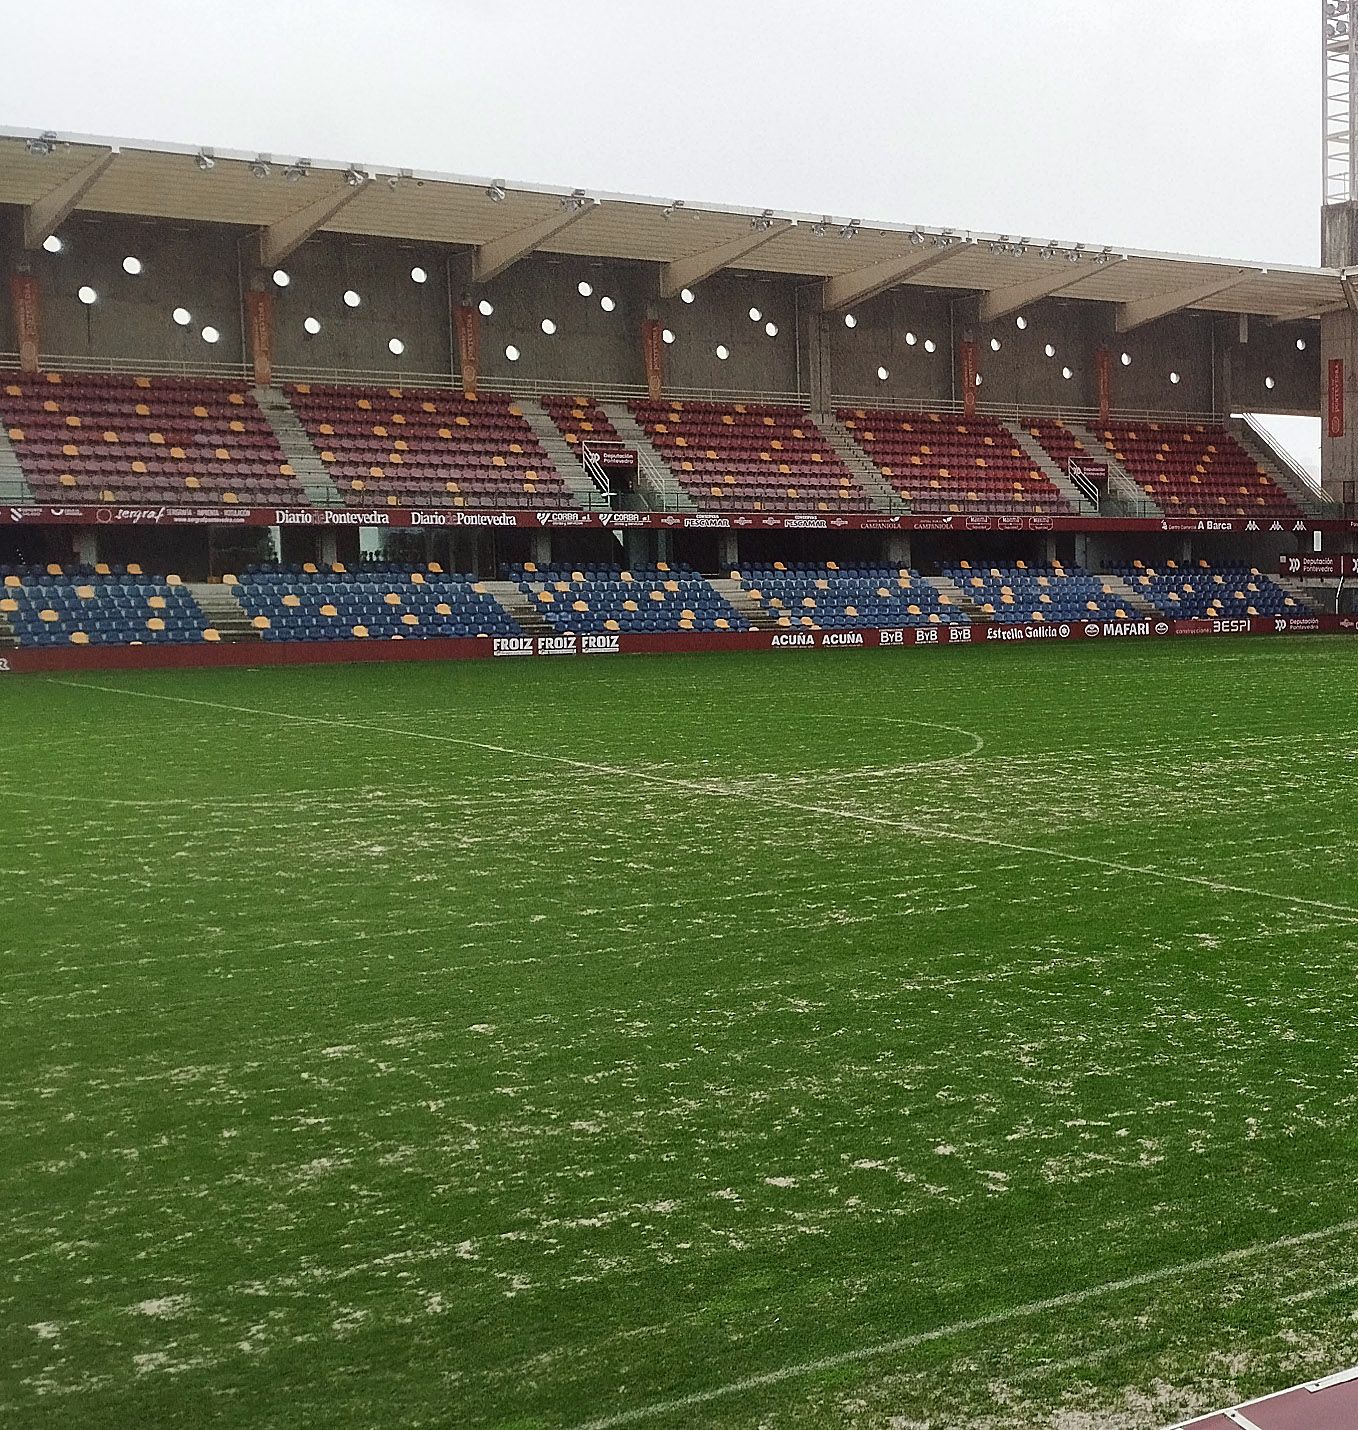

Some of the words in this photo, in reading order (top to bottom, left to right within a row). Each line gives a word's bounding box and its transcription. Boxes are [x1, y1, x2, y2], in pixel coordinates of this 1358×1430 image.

[275, 510, 312, 524] Diario
[324, 510, 389, 524] Pontevedra
[411, 512, 445, 525] Diario
[457, 512, 517, 526] Pontevedra
[684, 519, 730, 527] PESCAMAR
[785, 520, 827, 528] PESCAMAR
[1197, 521, 1205, 530] A
[1207, 521, 1232, 530] Barca
[987, 627, 1024, 640] Estrella
[1025, 625, 1057, 639] Galicia
[1103, 623, 1150, 636] MAFARI
[494, 637, 533, 650] FROIZ
[538, 637, 577, 650] FROIZ
[581, 635, 619, 648] FROIZ
[771, 632, 815, 646] ACUÑA
[822, 631, 864, 645] ACUÑA
